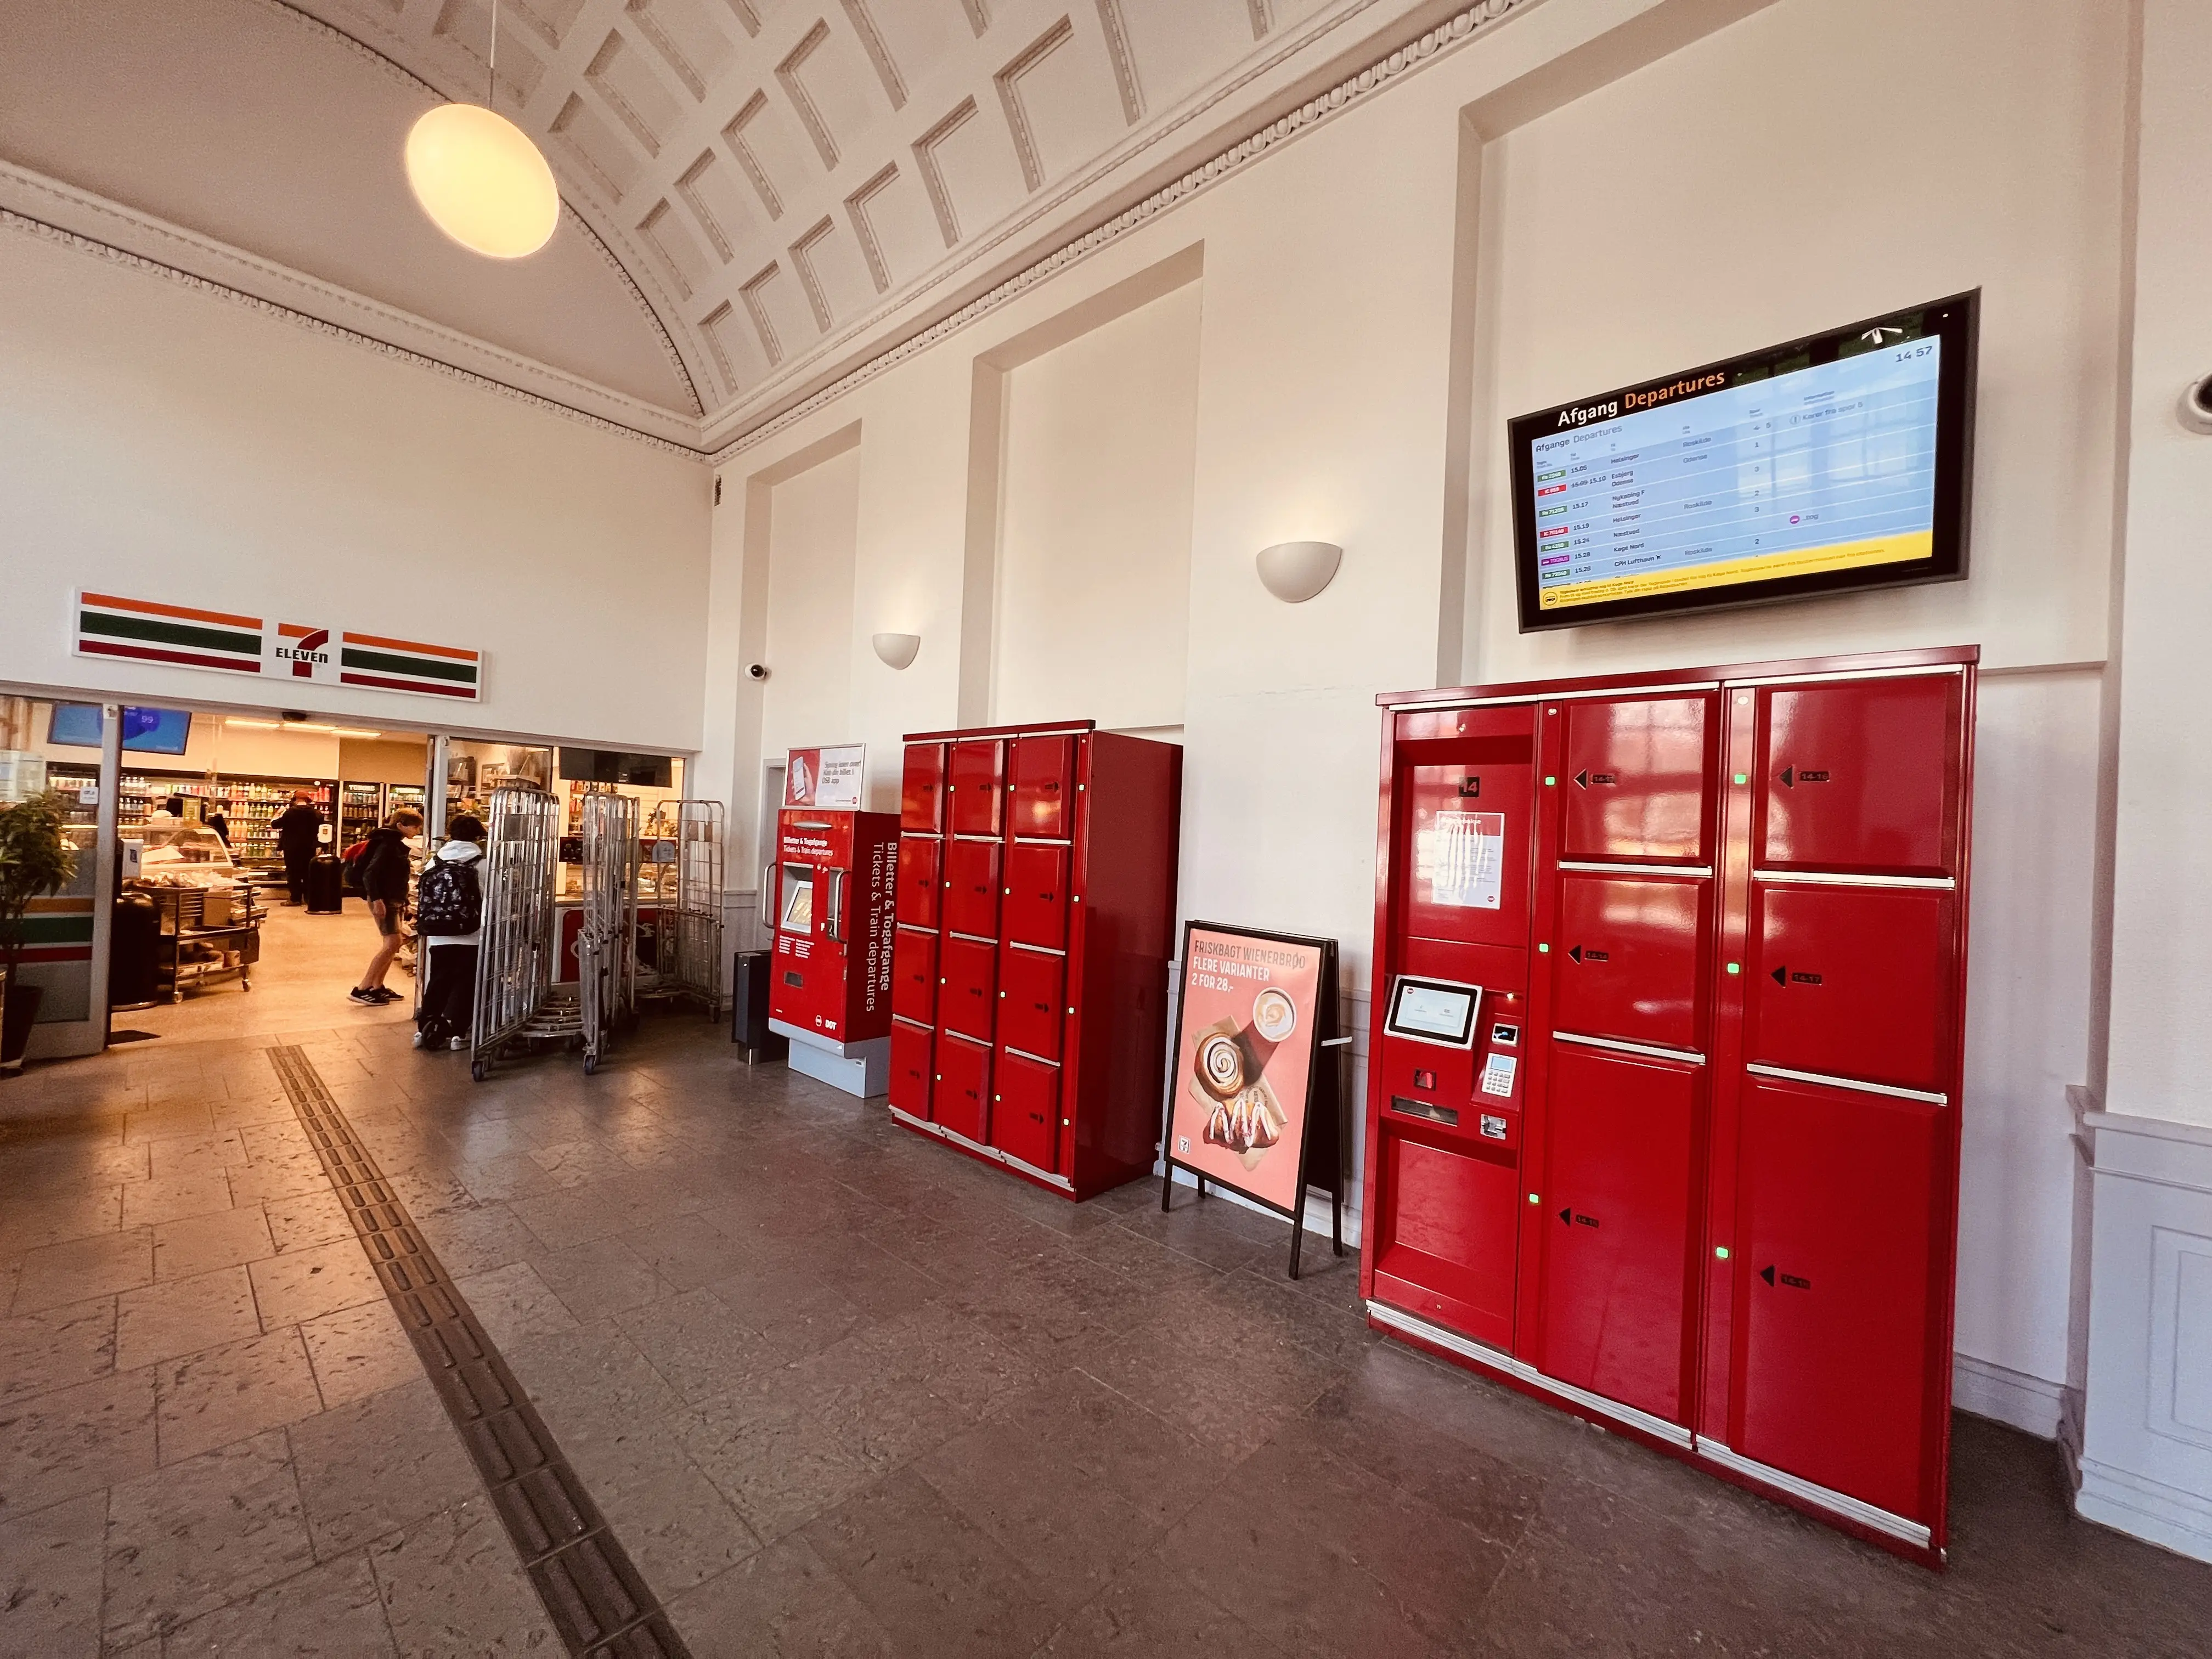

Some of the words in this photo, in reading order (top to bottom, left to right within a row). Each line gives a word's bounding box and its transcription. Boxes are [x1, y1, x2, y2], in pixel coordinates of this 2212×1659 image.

[1895, 351, 1911, 363] 14
[1915, 346, 1933, 358] 57
[1558, 401, 1617, 426] Afgang
[1625, 372, 1725, 409] Departures
[1536, 439, 1570, 452] Afgange
[1573, 426, 1623, 443] Departures
[1571, 465, 1587, 473] 15.05
[1683, 436, 1711, 448] Roskilde
[1589, 475, 1606, 484] 15.10
[1611, 471, 1634, 479] Esbjerg
[1683, 453, 1707, 464] Odense
[1611, 478, 1634, 487] Odense
[1572, 501, 1588, 509] 15.17
[1573, 522, 1589, 531] 15.19
[1684, 499, 1712, 510] Roskilde
[1684, 546, 1712, 556] Roskilde
[142, 715, 154, 724] 99
[1461, 780, 1478, 793] 14
[872, 842, 884, 887] Tickets
[885, 842, 898, 896] Billetter
[871, 891, 882, 901] &
[884, 900, 895, 910] &
[870, 905, 881, 937] Train
[879, 913, 894, 991] Togafgange
[1194, 940, 1242, 959] FRISKBAGT
[1243, 947, 1306, 969] WIENERBRØD
[866, 941, 879, 1012] departures
[1193, 956, 1218, 973] FLERE
[1220, 961, 1271, 981] VARIANTER
[1191, 973, 1198, 985] 2
[1199, 974, 1215, 989] FOR
[1216, 978, 1234, 992] 28,-
[825, 1019, 837, 1030] DOT
